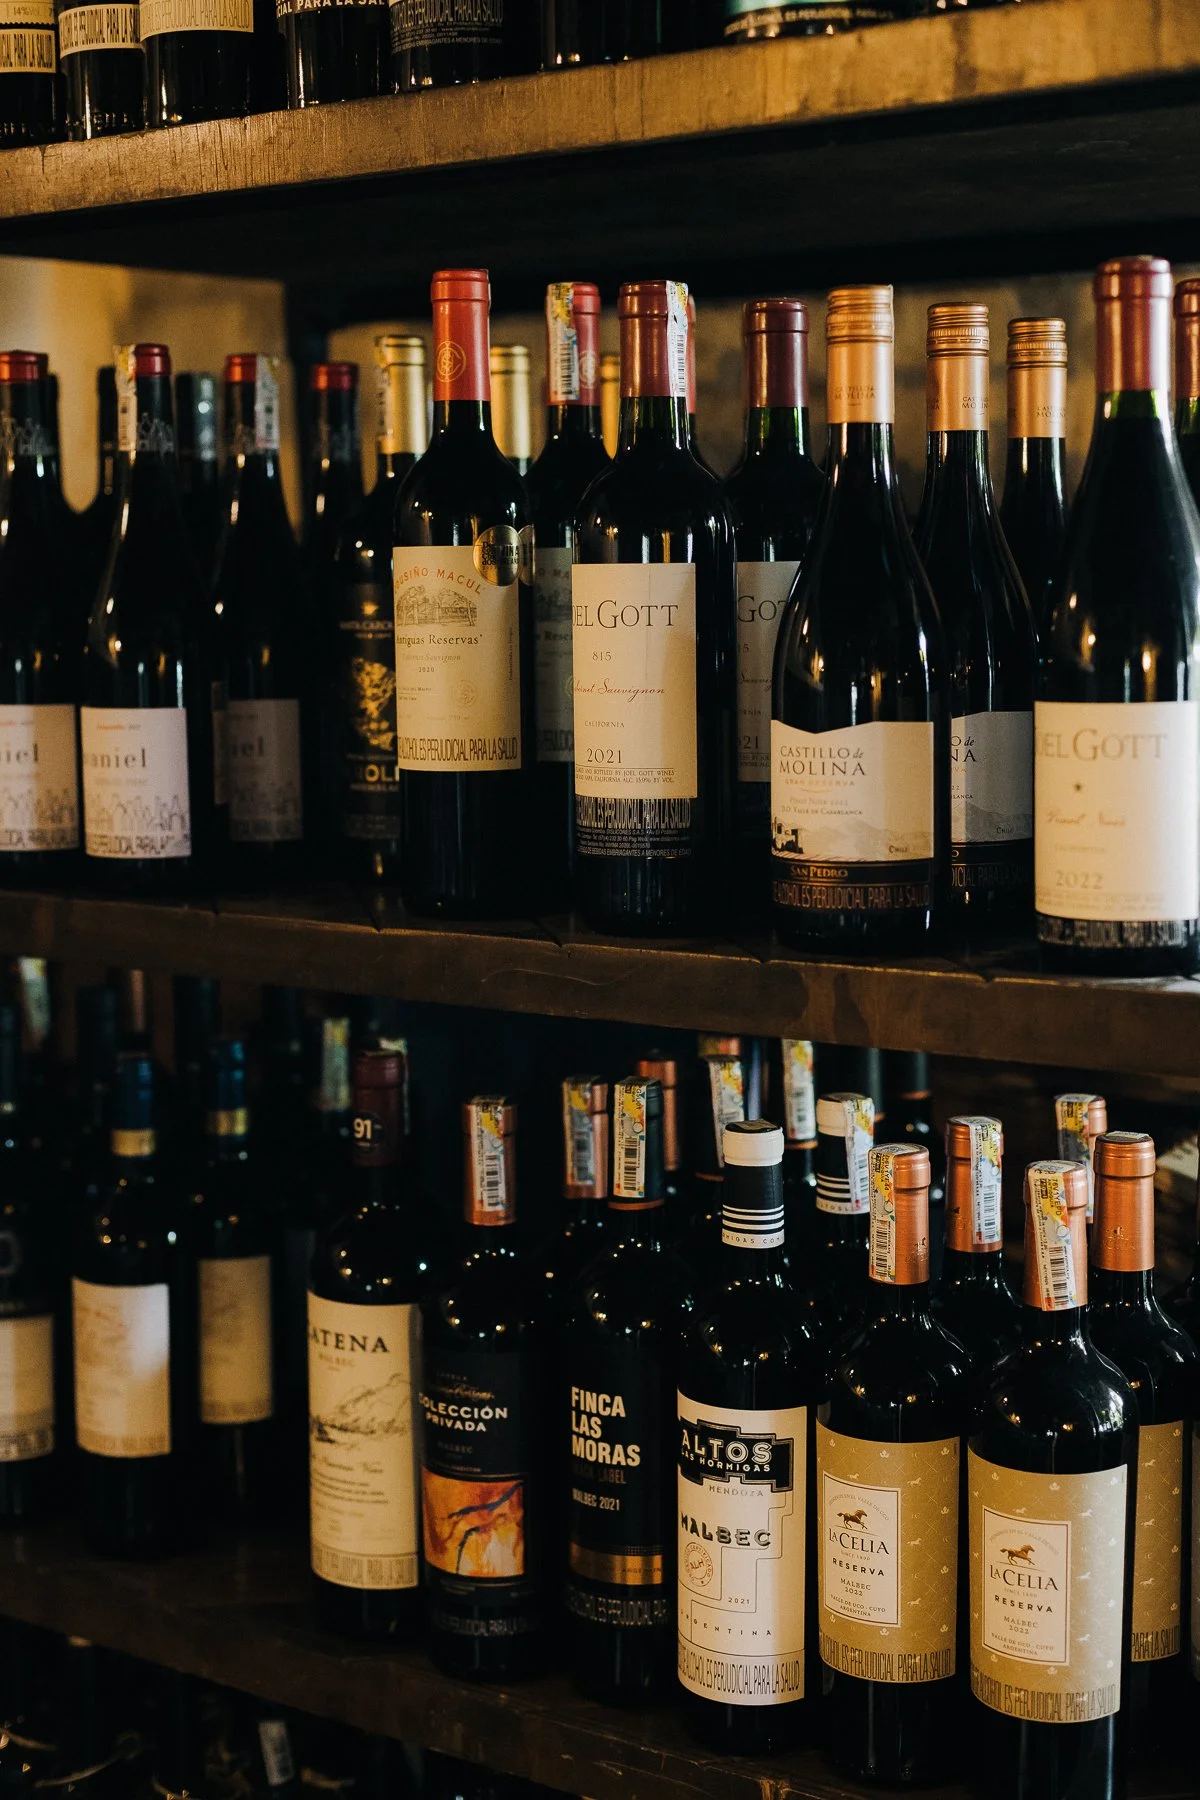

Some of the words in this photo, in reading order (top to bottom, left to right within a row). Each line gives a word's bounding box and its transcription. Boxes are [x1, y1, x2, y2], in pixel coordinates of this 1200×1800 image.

[106, 8, 119, 43] PARA
[436, 569, 484, 595] MACUL
[428, 634, 482, 646] Reservas
[592, 651, 612, 661] 815
[584, 720, 626, 729] CALIFORNIA
[428, 738, 469, 761] PERJUDICIAL
[470, 738, 487, 761] PARA
[489, 738, 497, 760] LA
[498, 736, 518, 760] SALUD
[963, 736, 975, 747] de
[0, 742, 38, 763] iel
[586, 747, 622, 763] 2021
[780, 745, 850, 759] CASTILLO
[852, 747, 865, 758] de
[779, 759, 867, 776] MOLINA
[642, 799, 660, 829] PARA
[670, 799, 691, 829] SALUD
[809, 866, 849, 879] PEDRO
[812, 886, 866, 910] PERJUDICIAL
[867, 886, 891, 910] PARA
[893, 886, 905, 909] LA
[906, 884, 930, 908] SALUD
[353, 1117, 373, 1140] 91
[308, 1326, 390, 1353] ATENA
[571, 1385, 627, 1418] FINCA
[425, 1410, 488, 1432] PRIVADA
[571, 1409, 603, 1440] LAS
[571, 1433, 641, 1468] MORAS
[681, 1428, 774, 1466] ALTOS
[698, 1456, 772, 1473] HORMIGAS
[709, 1484, 766, 1498] MENDOZA
[599, 1495, 621, 1512] 2021
[680, 1510, 772, 1547] MALBEC
[839, 1532, 889, 1556] CELIA
[832, 1557, 885, 1577] RESERVA
[840, 1577, 871, 1591] MALBEC
[1002, 1568, 1059, 1592] CELIA
[727, 1597, 751, 1605] 2021
[844, 1586, 864, 1597] 2022
[840, 1605, 872, 1617] ARGENTINA
[994, 1594, 1054, 1613] RESERVA
[1003, 1615, 1040, 1629] MALBEC
[1008, 1624, 1030, 1635] 2022
[842, 1643, 850, 1673] ES
[850, 1647, 896, 1681] PERJUDICIAL
[897, 1653, 918, 1682] PARA
[919, 1652, 929, 1680] LA
[930, 1648, 952, 1680] SALUD
[714, 1661, 753, 1695] PERJUDICIAL
[754, 1664, 771, 1695] PARA
[772, 1663, 780, 1694] LA
[781, 1660, 800, 1693] SALUD
[1014, 1686, 1062, 1722] PERJUDICIAL
[1065, 1691, 1088, 1721] PARA
